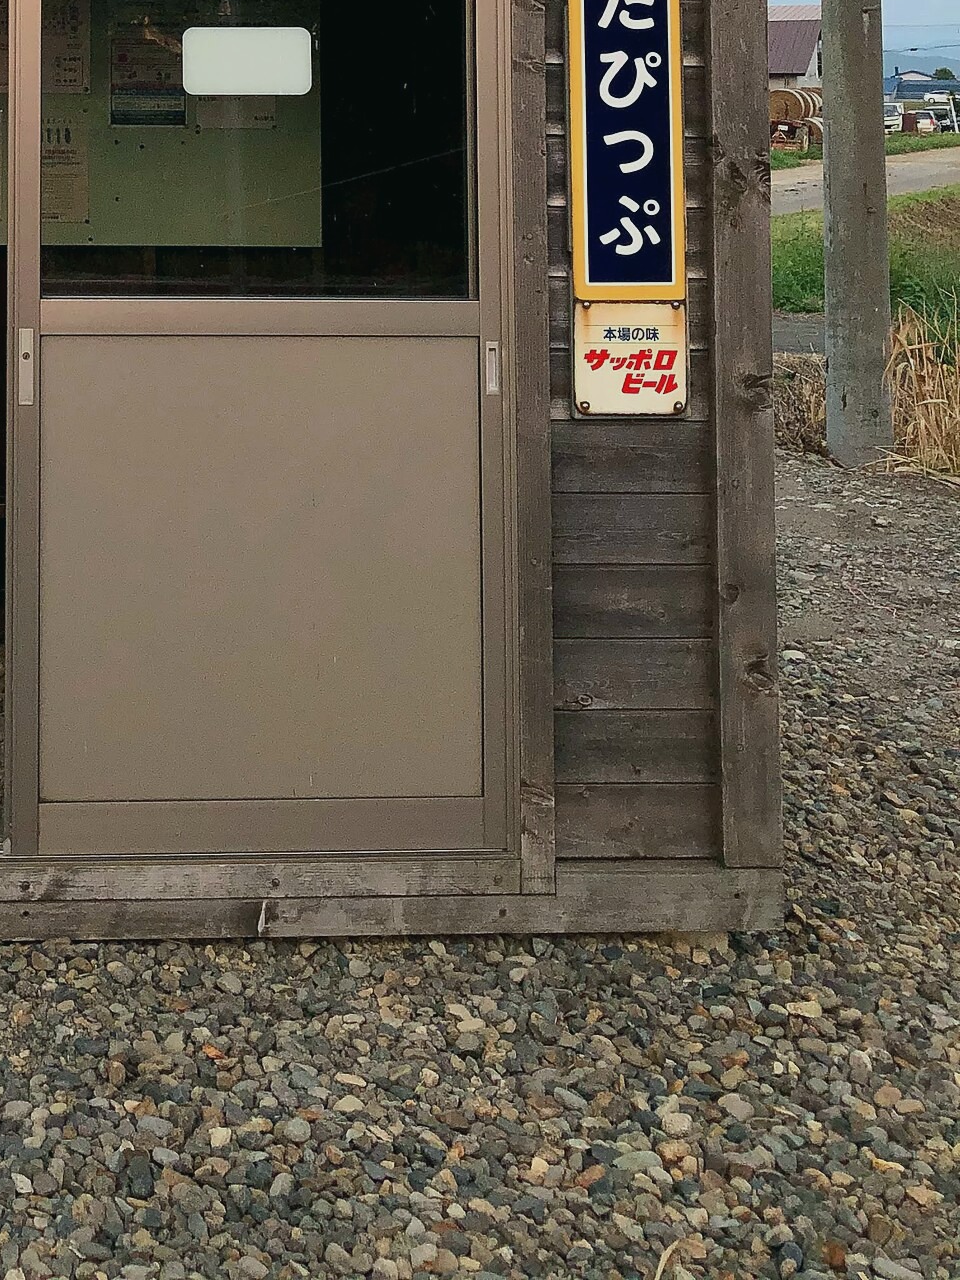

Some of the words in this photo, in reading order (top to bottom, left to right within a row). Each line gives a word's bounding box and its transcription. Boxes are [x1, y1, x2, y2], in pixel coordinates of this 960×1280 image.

[603, 327, 660, 342] 本場の味
[583, 348, 678, 371] サッポロ
[621, 373, 679, 395] ビール
